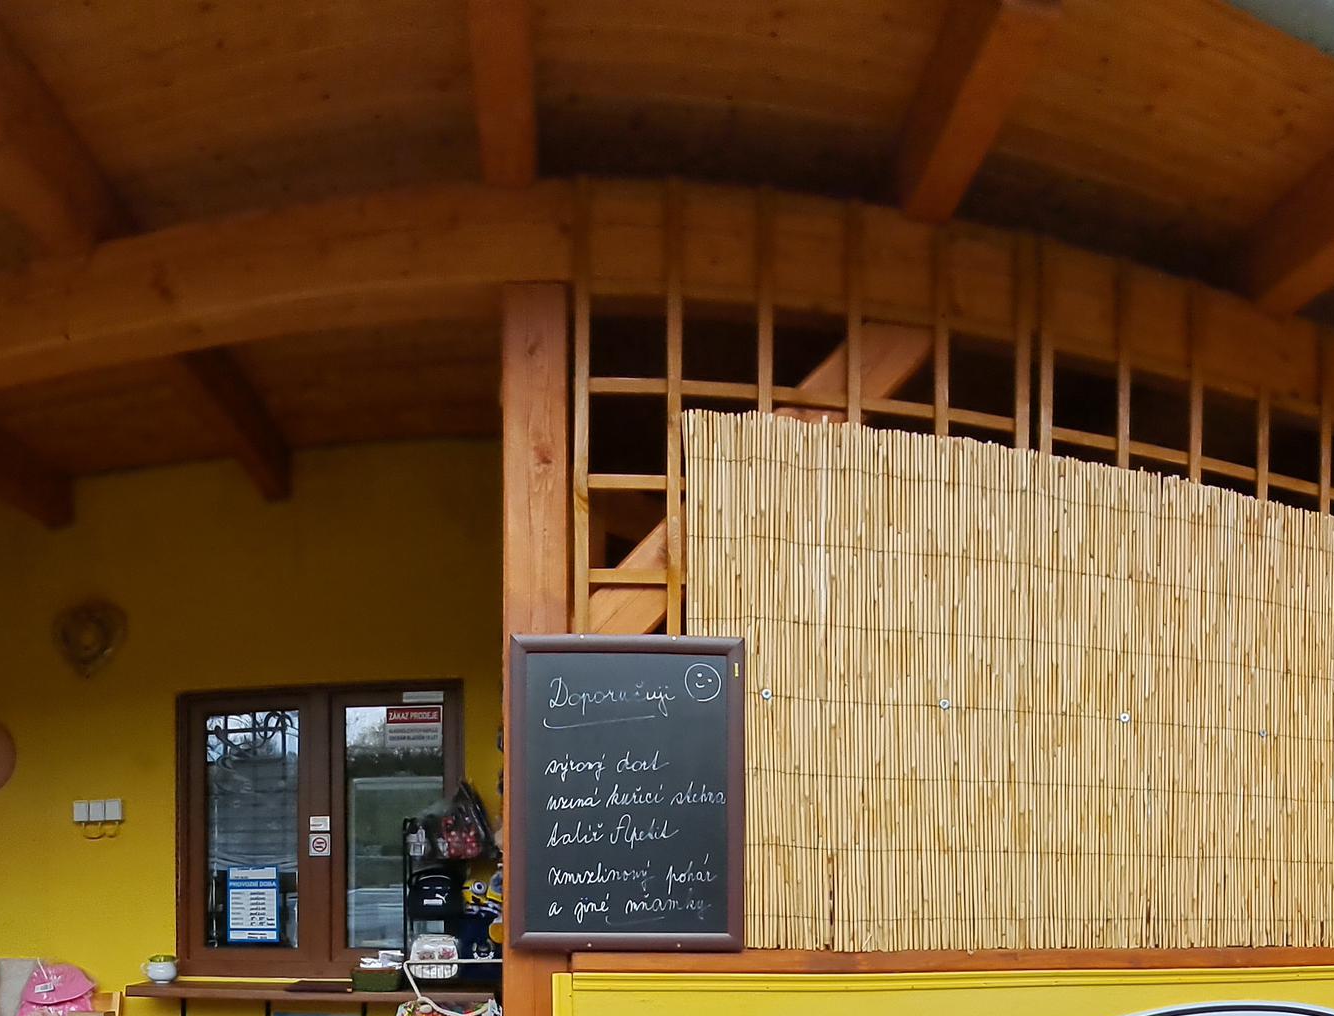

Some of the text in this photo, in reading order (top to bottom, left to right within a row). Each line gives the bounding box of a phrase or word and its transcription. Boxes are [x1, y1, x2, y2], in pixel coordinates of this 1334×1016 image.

[616, 751, 669, 773] dort
[546, 821, 604, 848] talíř
[666, 853, 717, 894] pohár
[548, 901, 563, 917] a
